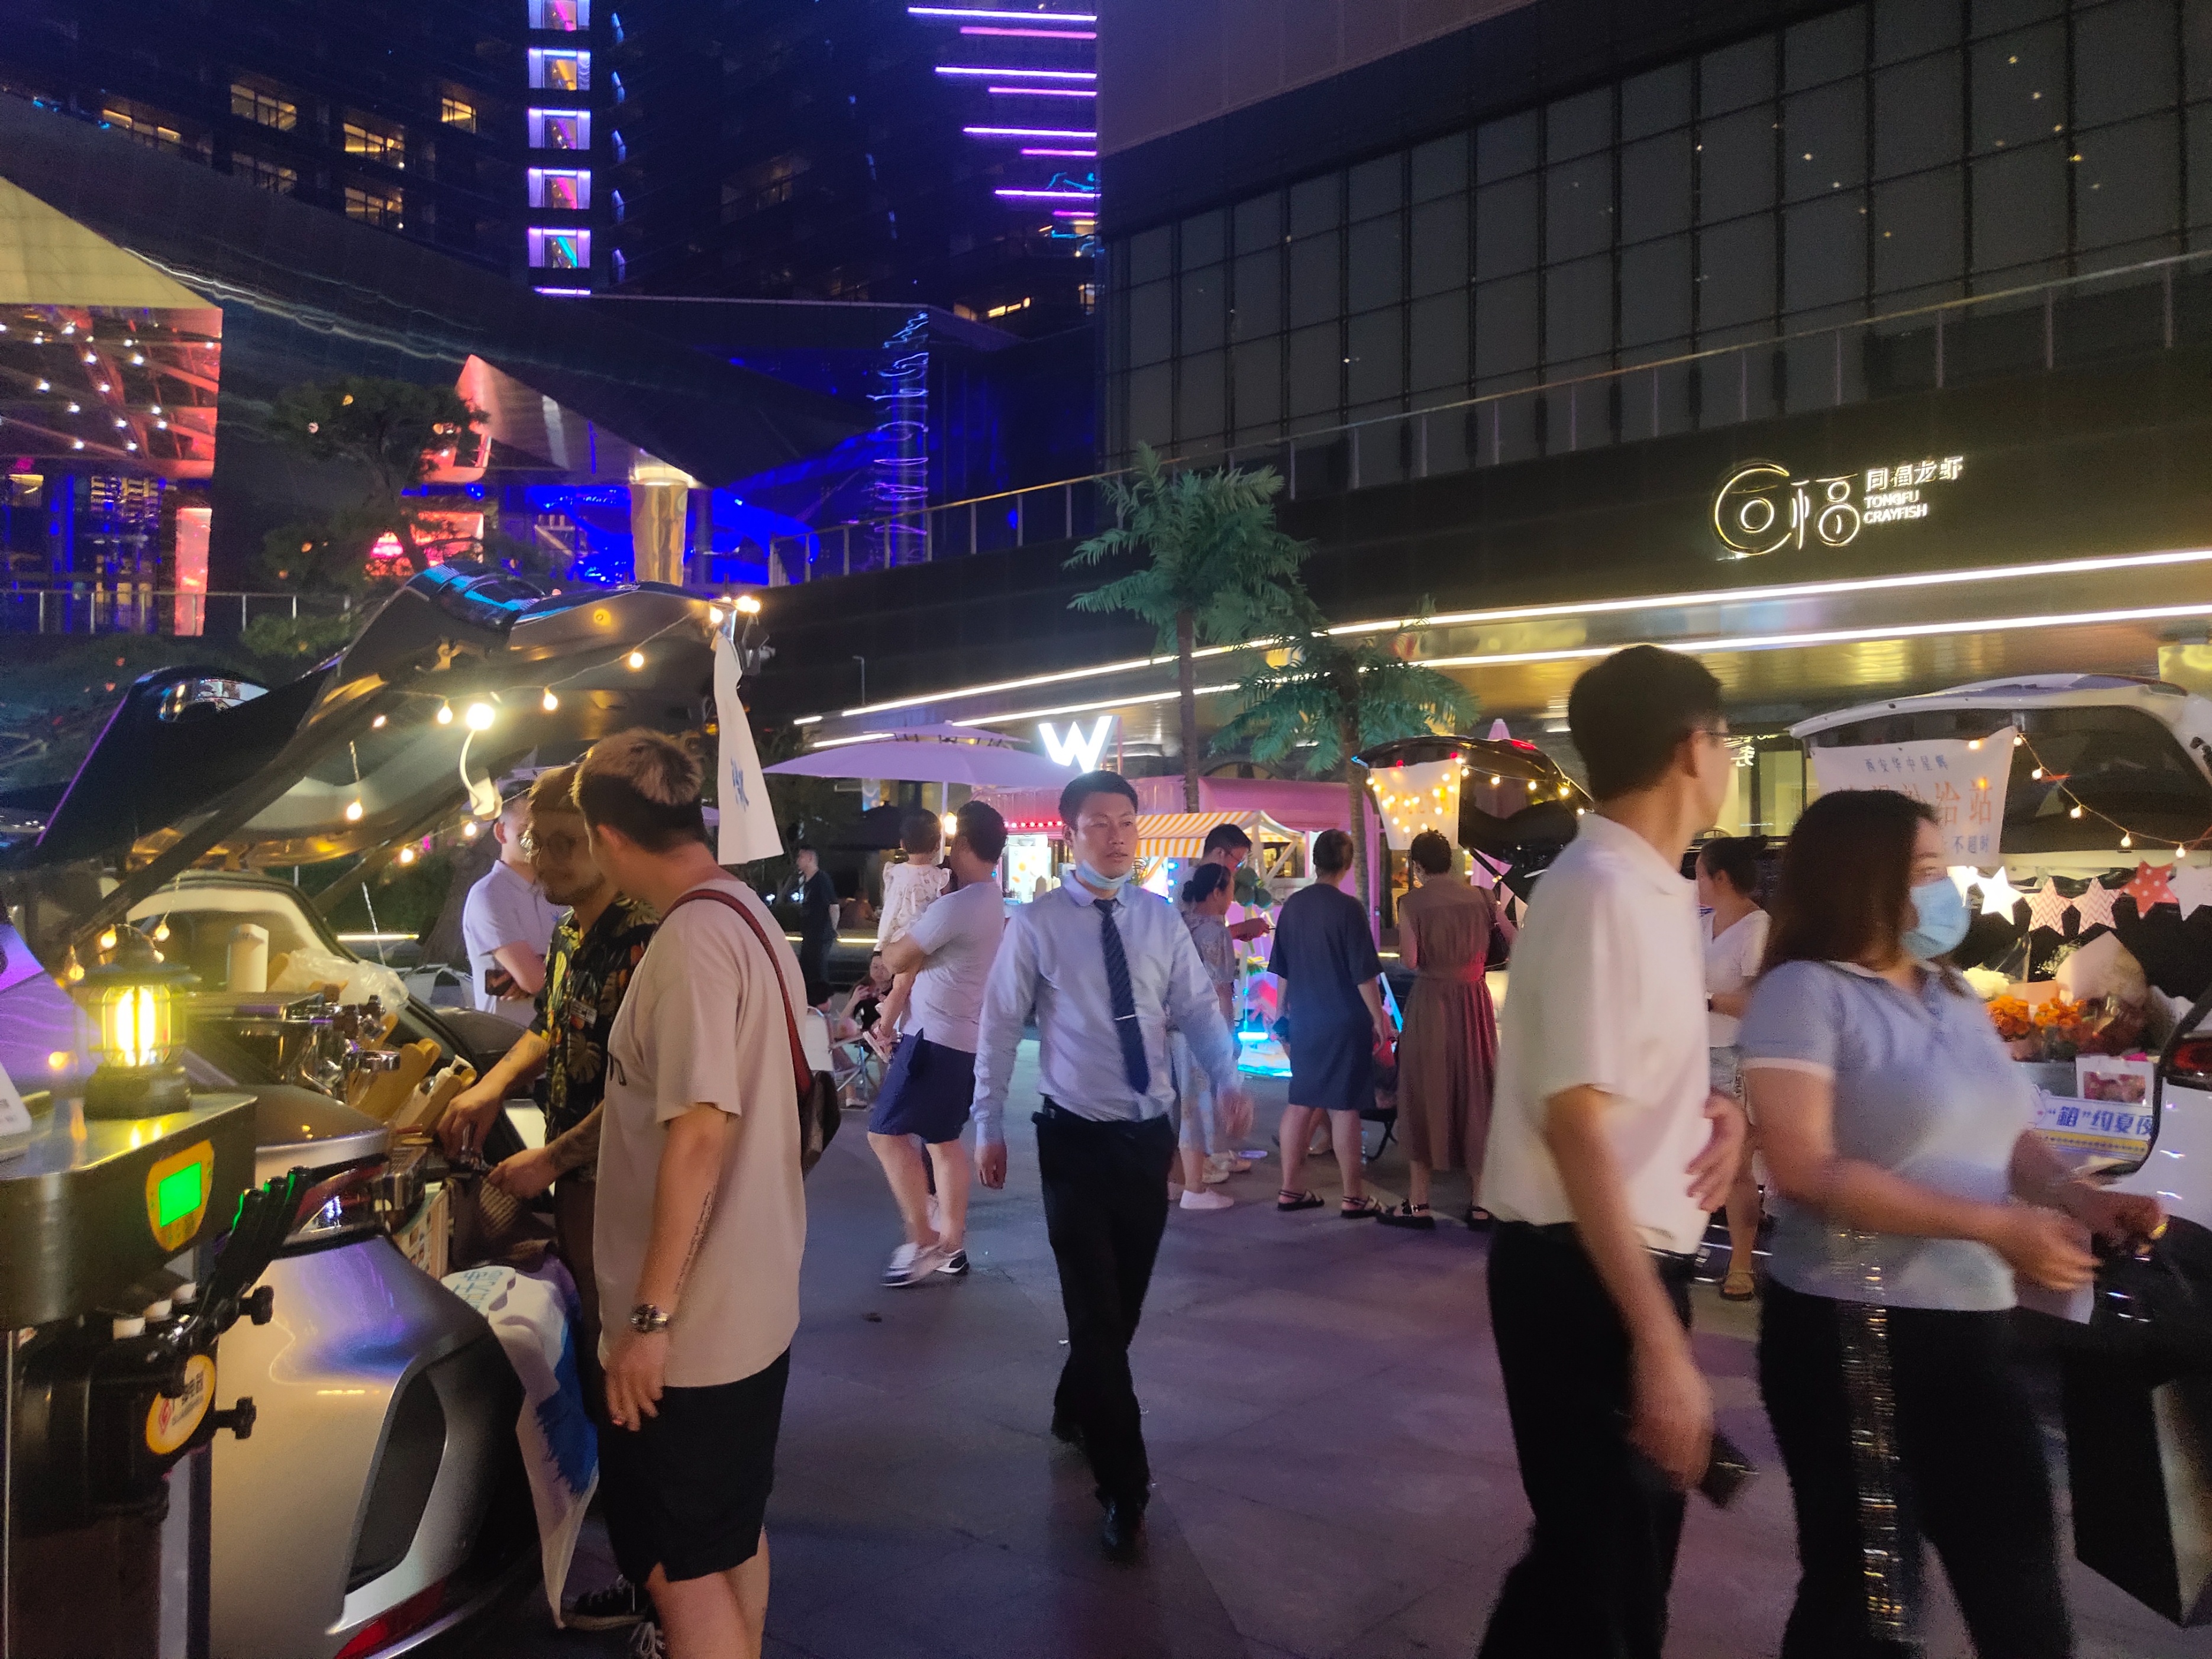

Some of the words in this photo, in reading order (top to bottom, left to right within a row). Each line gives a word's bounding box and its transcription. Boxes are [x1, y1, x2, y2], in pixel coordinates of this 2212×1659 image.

[1866, 456, 1963, 492] 同福龙虾
[1864, 489, 1920, 509] TONGFU
[1864, 503, 1927, 524] CRAYFISH
[1039, 715, 1115, 773] W
